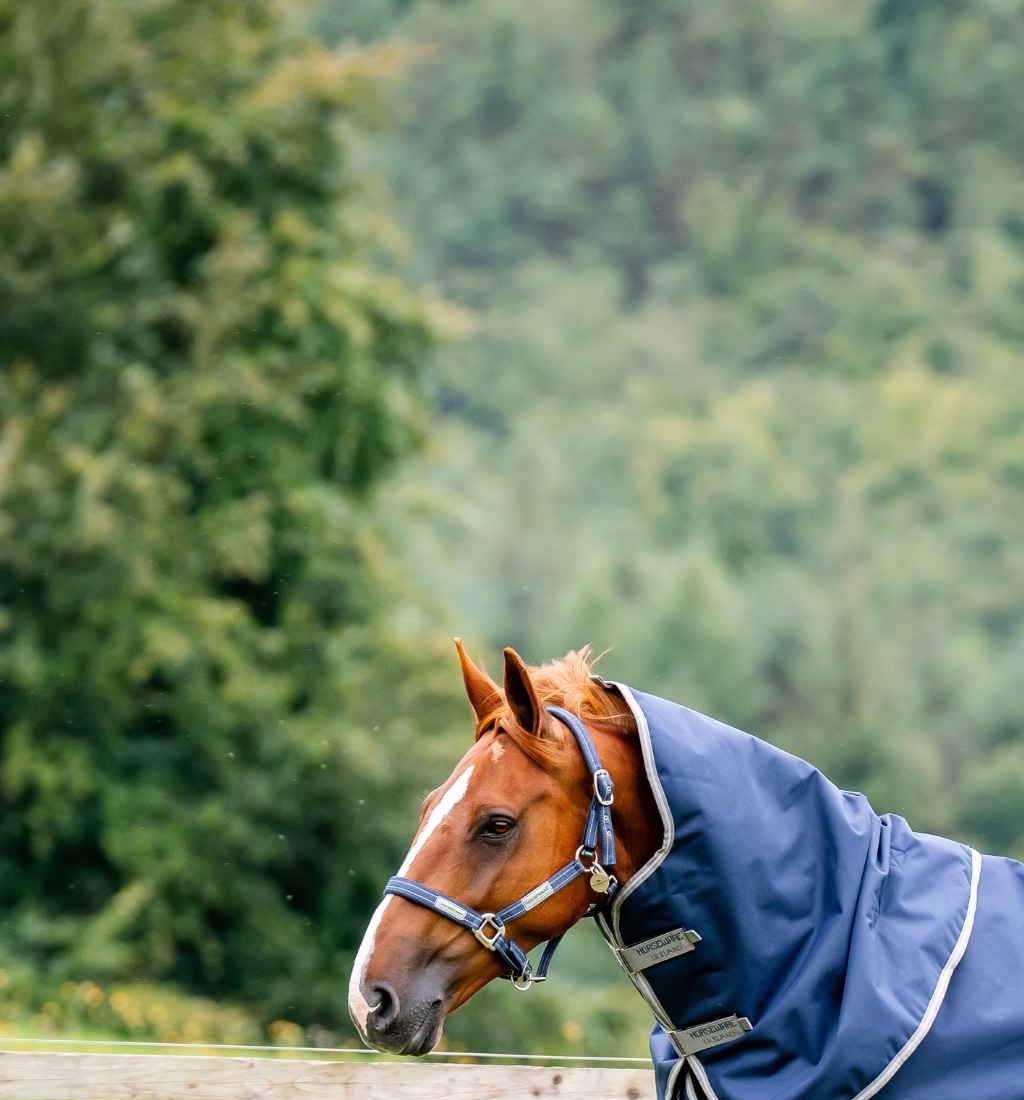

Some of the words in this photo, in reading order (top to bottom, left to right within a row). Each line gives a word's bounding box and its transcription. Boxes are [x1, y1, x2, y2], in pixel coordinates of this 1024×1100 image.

[635, 932, 684, 956] HORSEWARE
[651, 945, 683, 961] IRELAND
[689, 1019, 738, 1040] HORSEWARE
[704, 1031, 736, 1045] IRELAND
